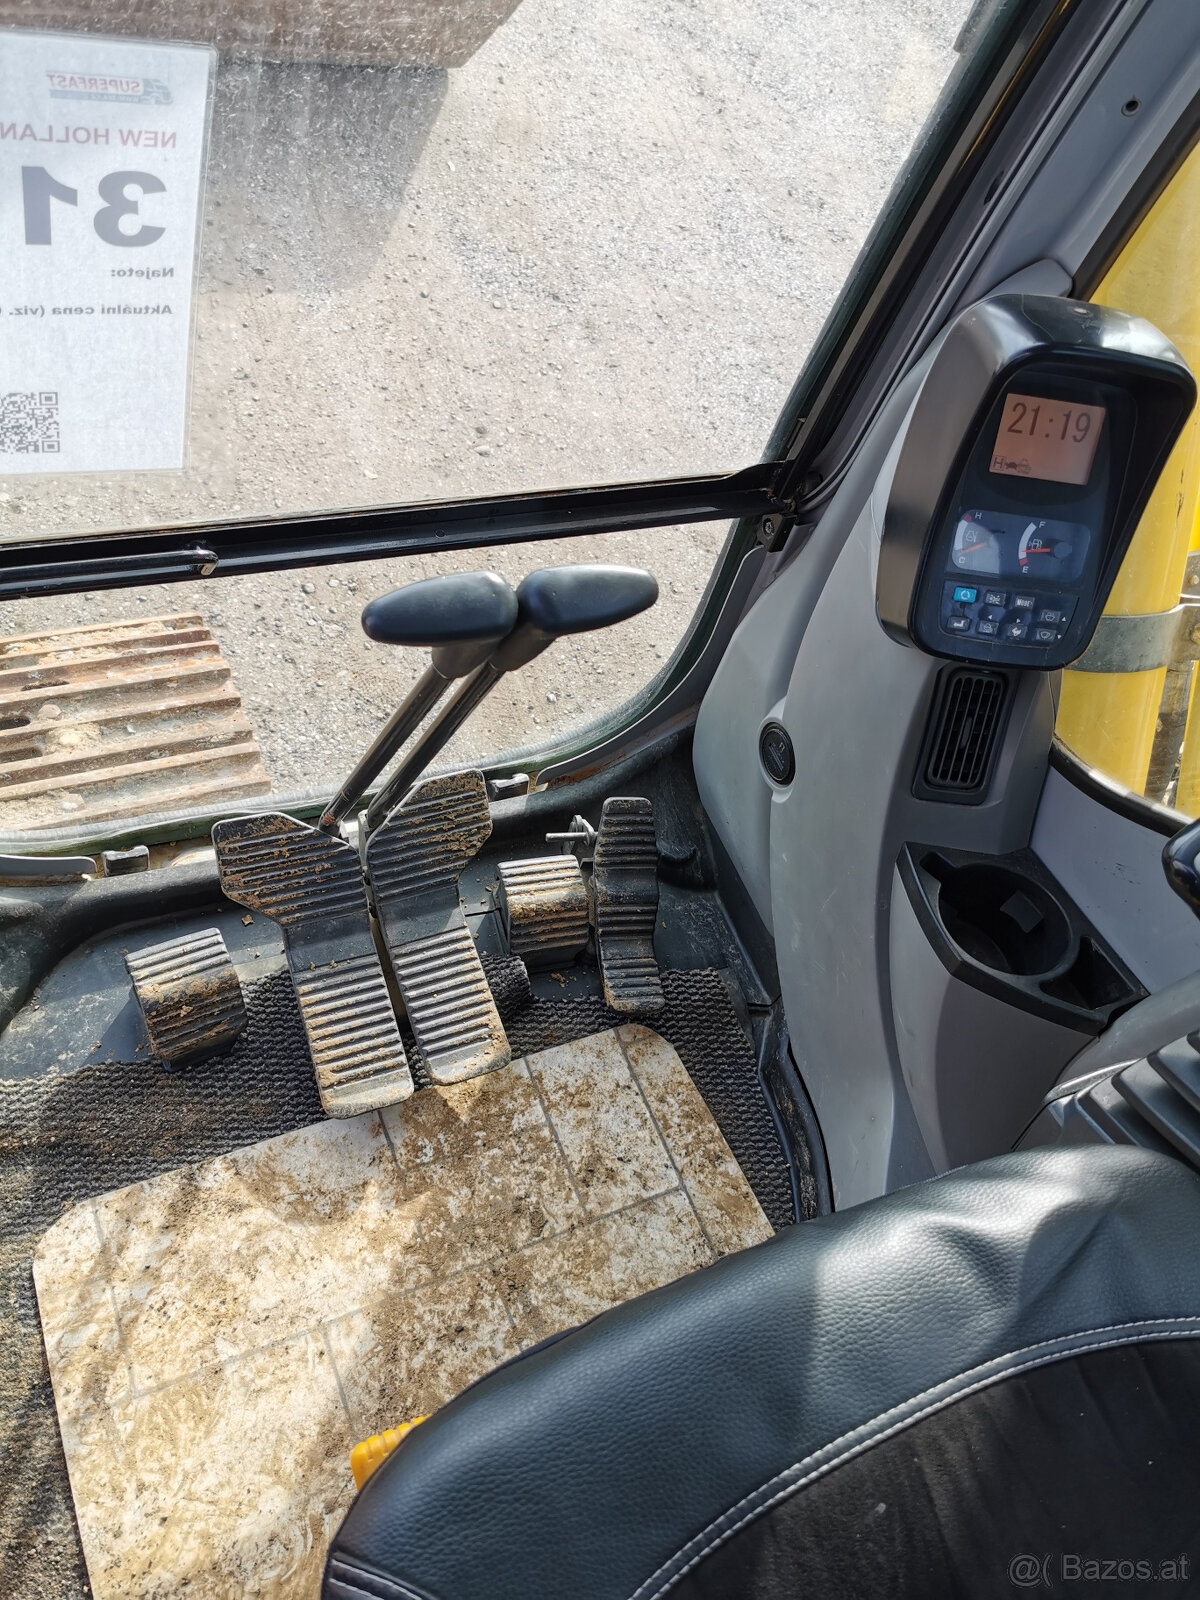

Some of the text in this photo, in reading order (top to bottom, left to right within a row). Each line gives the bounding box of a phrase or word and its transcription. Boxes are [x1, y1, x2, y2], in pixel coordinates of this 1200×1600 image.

[1007, 402, 1092, 443] 21:19
[975, 511, 983, 520] H
[1038, 521, 1046, 529] F
[958, 556, 966, 564] C
[1022, 566, 1029, 574] E
